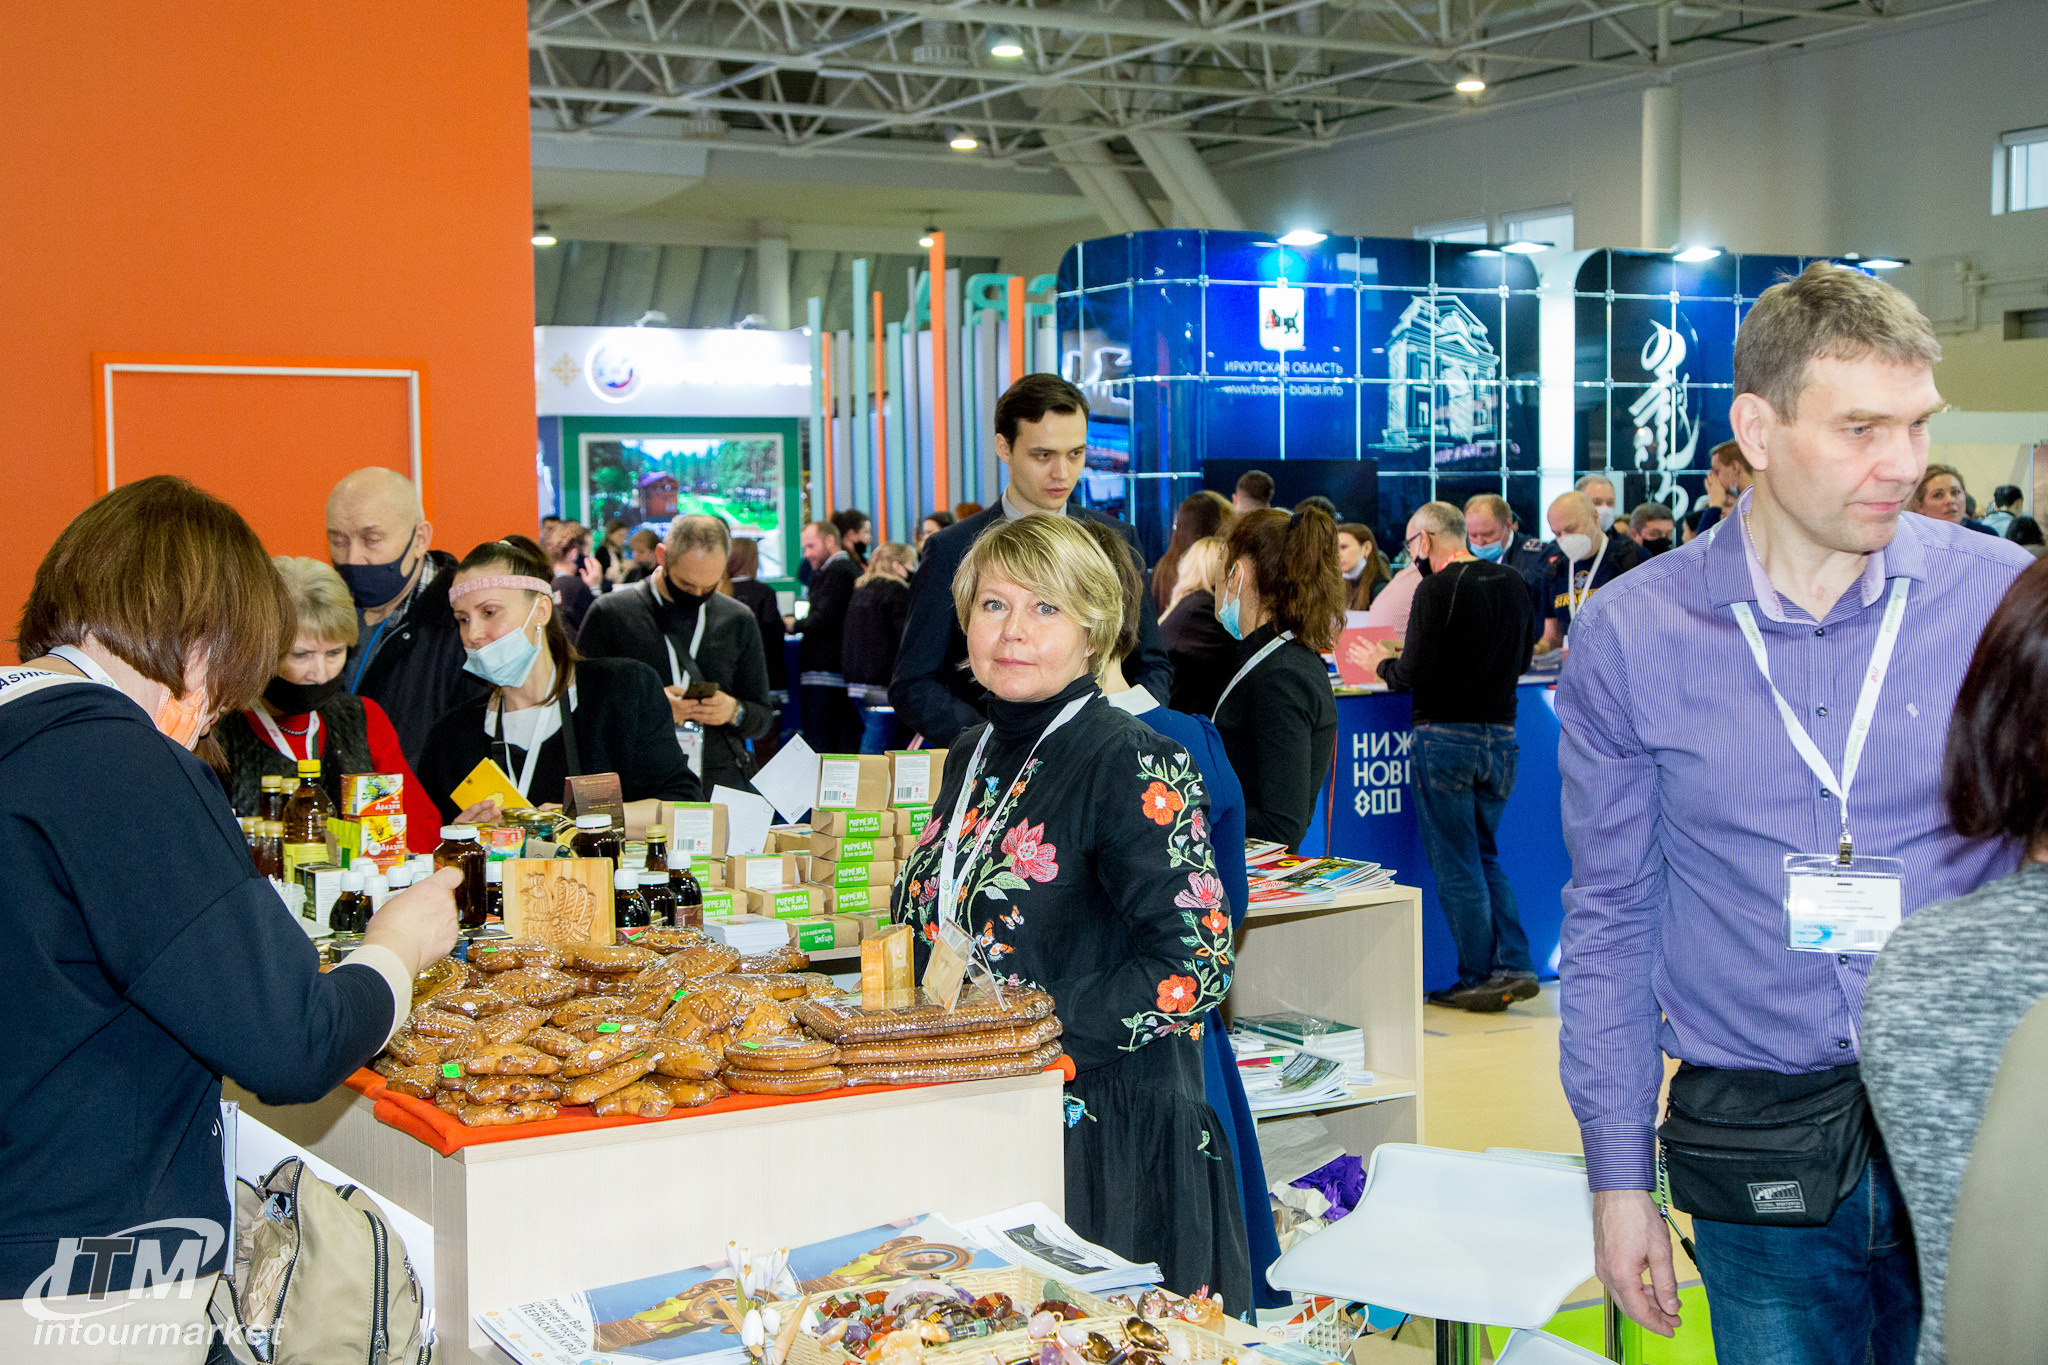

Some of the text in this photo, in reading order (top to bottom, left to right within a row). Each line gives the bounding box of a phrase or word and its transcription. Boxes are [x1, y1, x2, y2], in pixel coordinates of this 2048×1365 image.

[1224, 361, 1344, 375] ИРКУТСКАЯ ОБЛАСТЬ
[1219, 384, 1344, 397] www.trave-baikal.info
[0, 671, 52, 690] ASHI
[518, 1303, 564, 1341] ПЕРМСКИЙ
